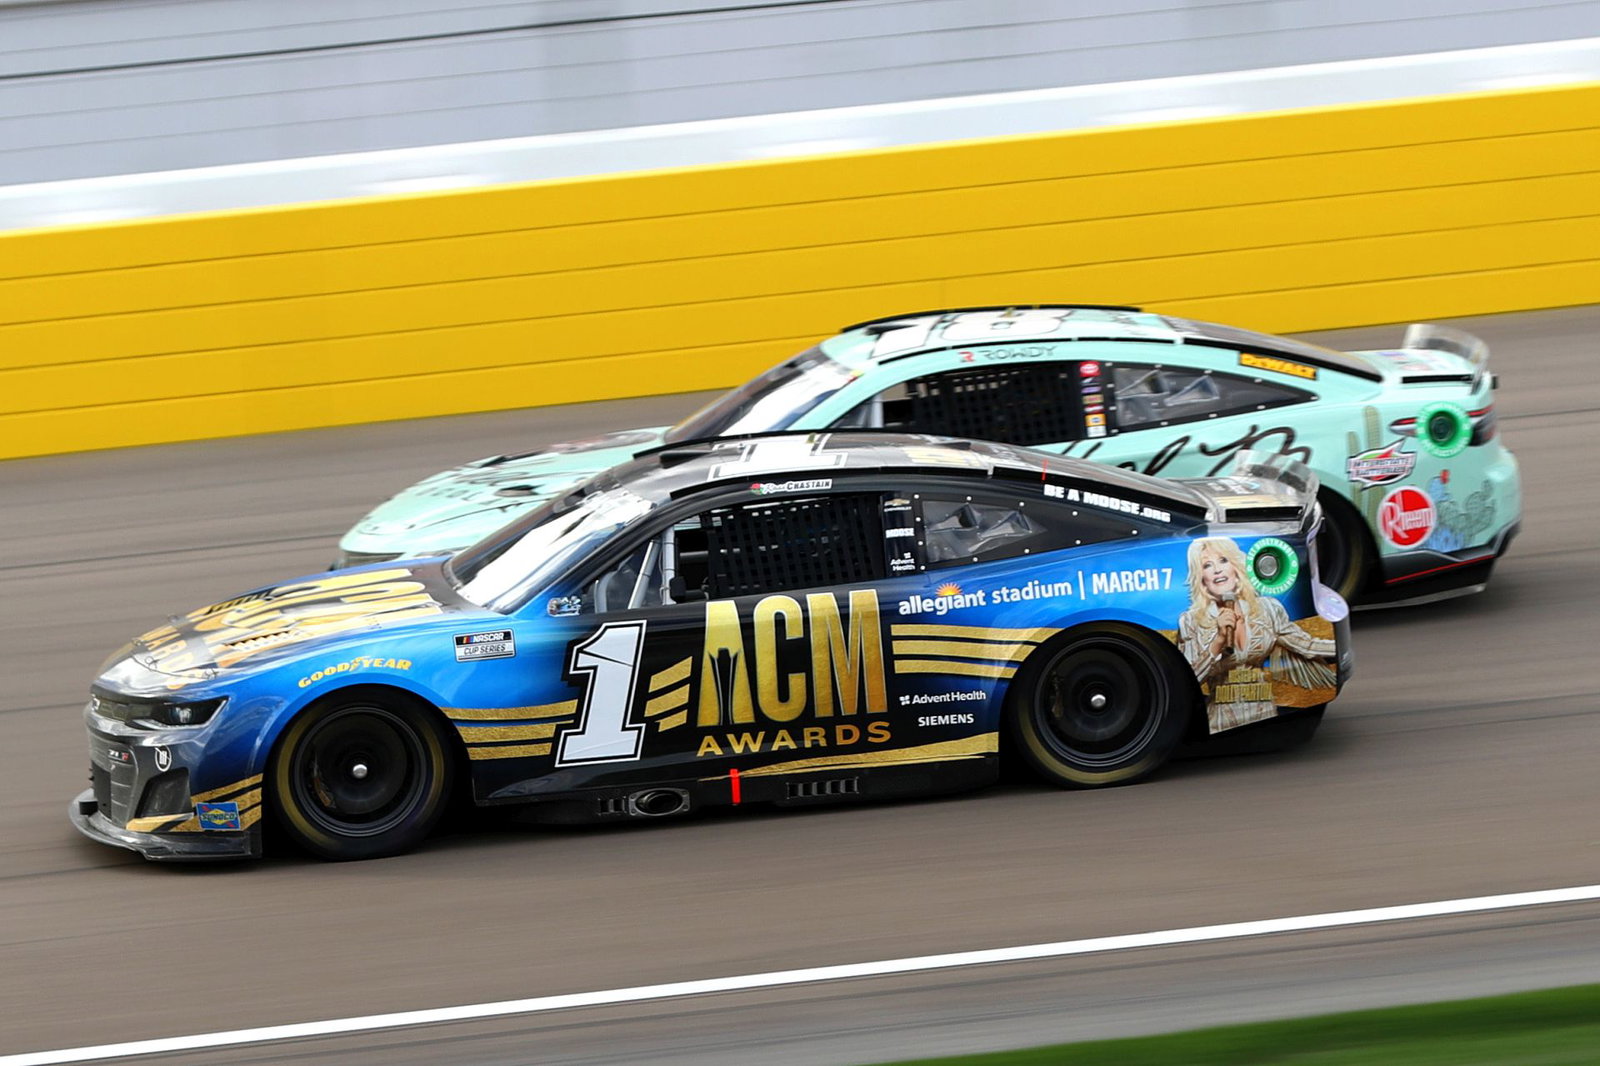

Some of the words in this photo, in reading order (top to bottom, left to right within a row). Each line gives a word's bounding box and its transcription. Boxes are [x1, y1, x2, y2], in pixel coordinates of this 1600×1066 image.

[1043, 484, 1065, 498] BE
[1067, 488, 1080, 502] A
[1083, 491, 1171, 523] MOOSE.ORG
[898, 588, 986, 616] allegiant
[992, 579, 1072, 604] stadium
[1092, 570, 1160, 596] MARCH
[1162, 568, 1173, 590] 7
[464, 646, 479, 655] CUP
[480, 644, 506, 653] SERIES
[473, 632, 505, 643] NASCAR
[298, 656, 412, 688] GOODYEAR
[696, 589, 888, 727] ACM
[554, 619, 647, 768] 1
[918, 713, 974, 727] SIEMENS
[696, 721, 891, 757] AWARDS
[200, 812, 236, 822] SUNOCO
